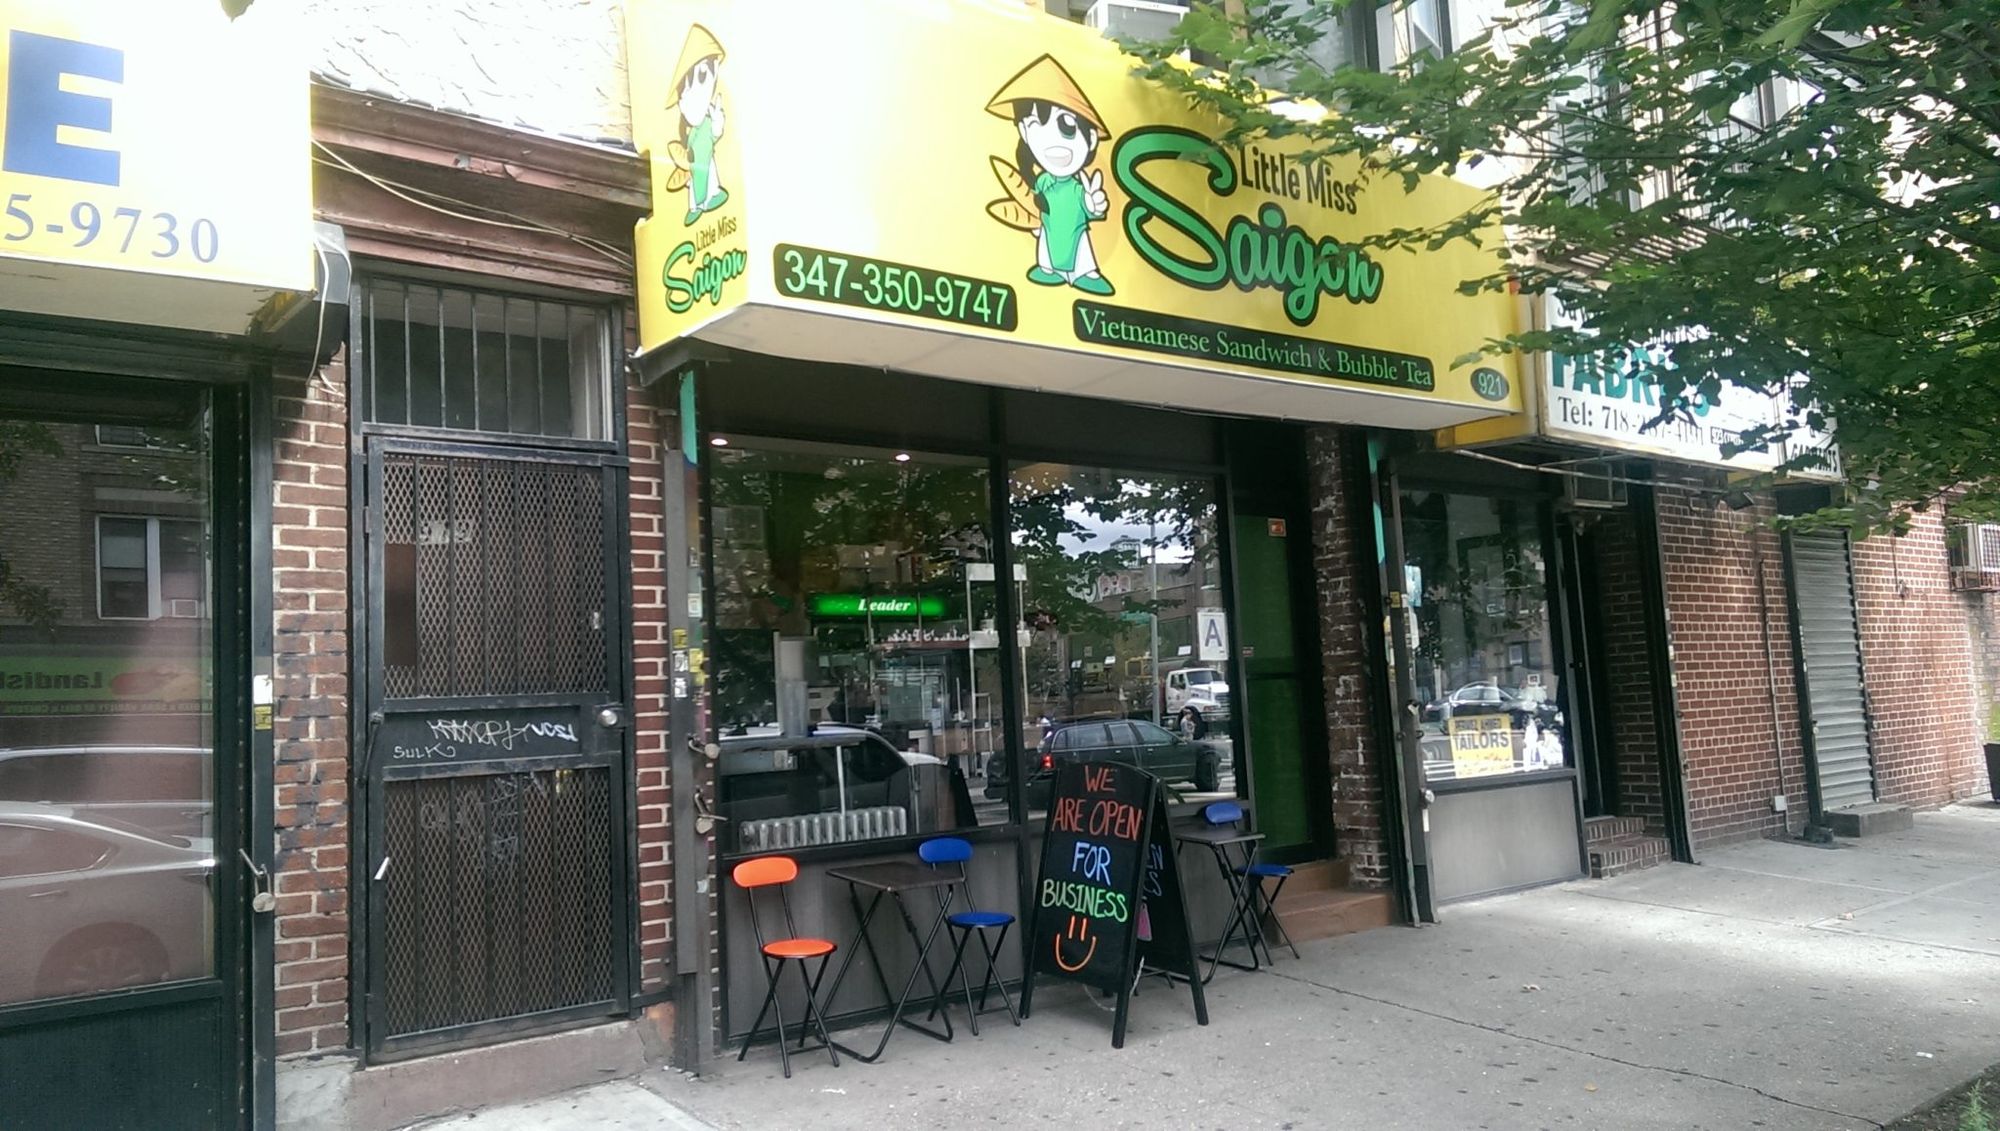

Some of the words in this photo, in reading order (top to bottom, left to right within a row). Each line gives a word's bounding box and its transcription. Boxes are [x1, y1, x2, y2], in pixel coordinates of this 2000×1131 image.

[2, 29, 124, 187] E
[1241, 144, 1300, 200] Little
[1305, 159, 1357, 215] Miss
[3, 193, 219, 263] 5-9730
[695, 224, 717, 252] Little
[717, 216, 737, 241] Miss
[1111, 125, 1383, 326] Saigon
[662, 240, 748, 314] Saigon
[784, 249, 1009, 326] 347-350-9747
[1077, 306, 1211, 352] Vietnamese
[1216, 331, 1313, 368] Sandwich
[1317, 346, 1332, 371] &
[1337, 350, 1398, 380] Bubble
[1401, 360, 1432, 386] Tea
[1477, 372, 1504, 396] 921
[1558, 396, 1593, 427] Tel:
[858, 598, 911, 611] Leader
[1204, 618, 1223, 648] A
[1454, 731, 1509, 751] TAILORS
[1084, 765, 1117, 793] WE
[1052, 797, 1086, 832] ARE
[1089, 800, 1143, 841] OPEN
[1071, 841, 1111, 886] FOR
[1041, 878, 1128, 923] BUSINESS
